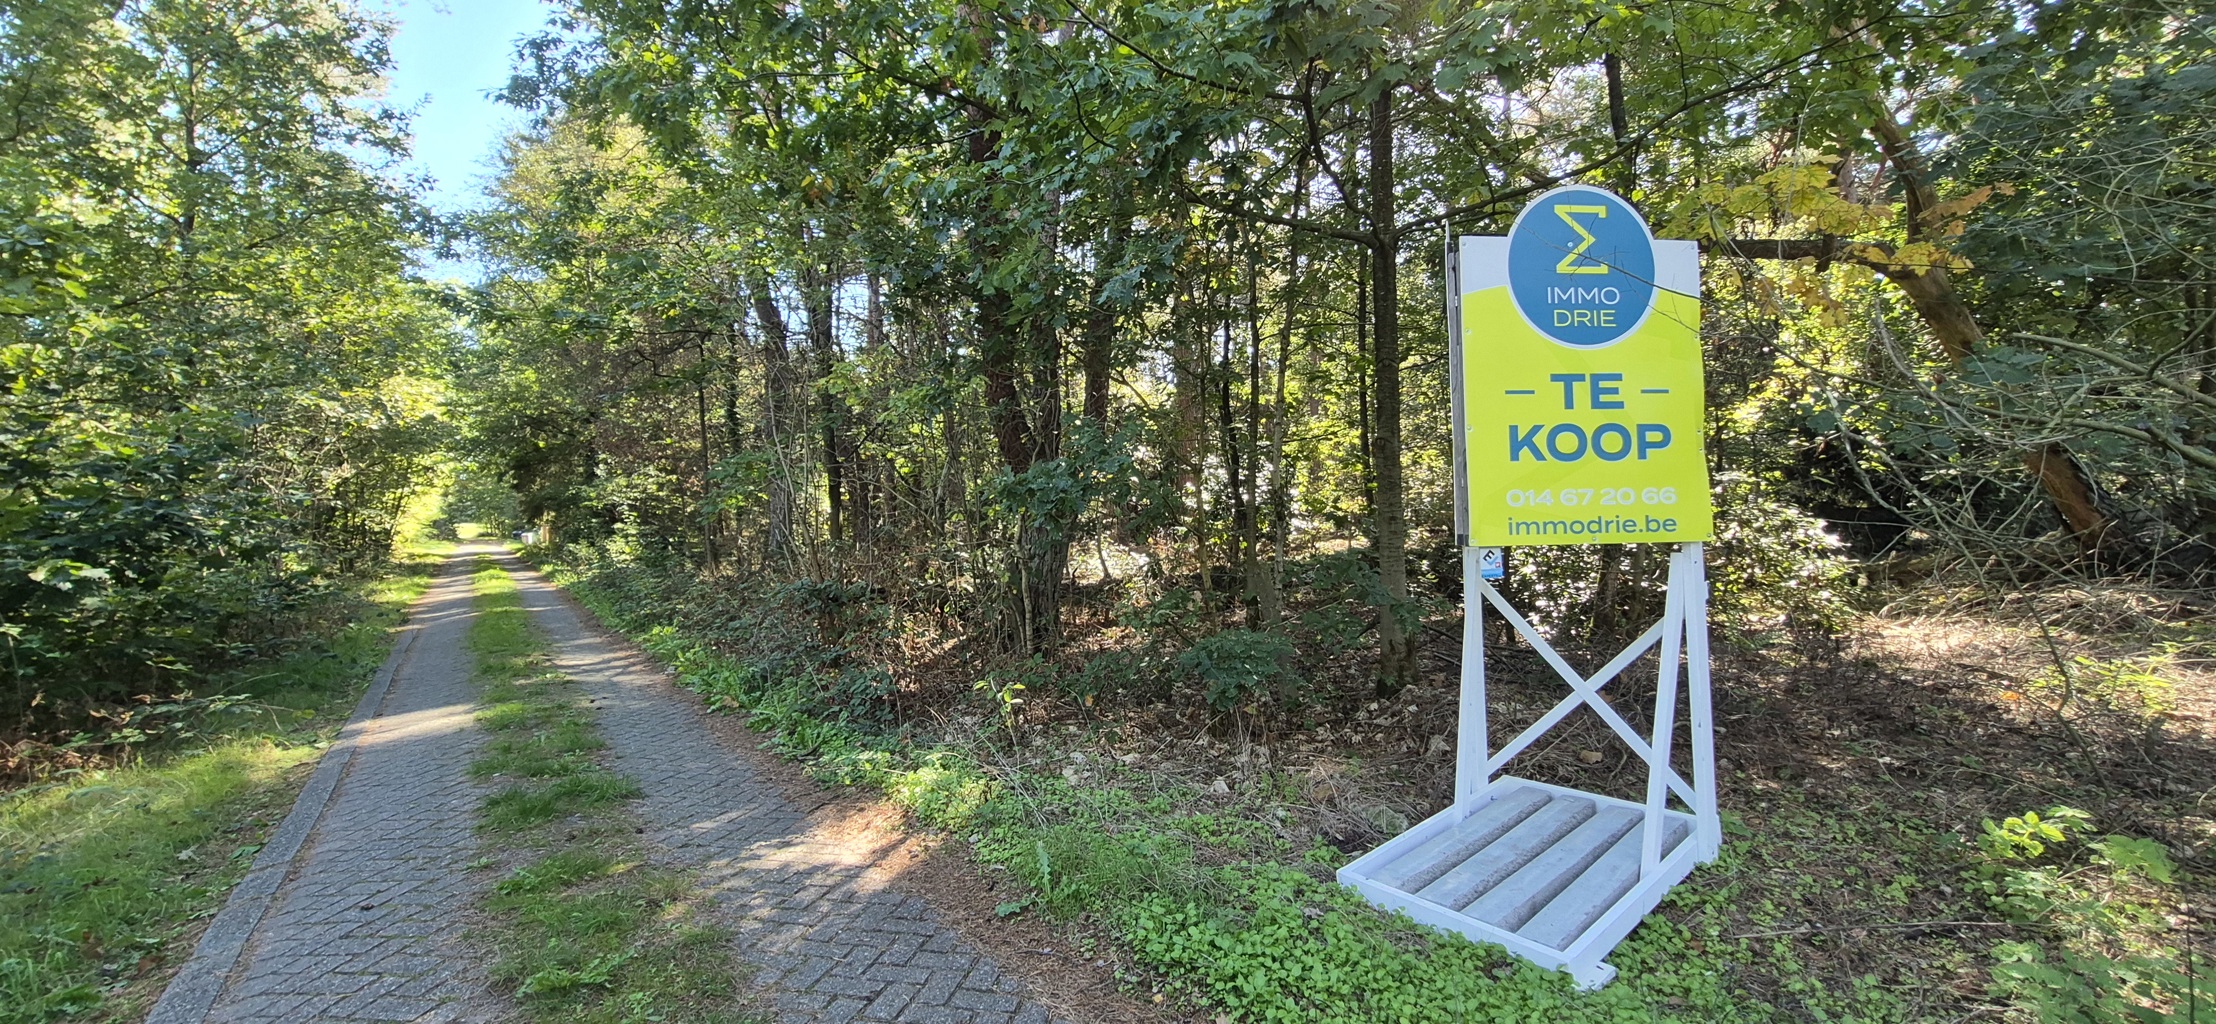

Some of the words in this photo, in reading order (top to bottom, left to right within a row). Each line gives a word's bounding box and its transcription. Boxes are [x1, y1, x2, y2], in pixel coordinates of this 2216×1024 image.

[1547, 286, 1620, 304] IMMO
[1554, 310, 1616, 327] DRIE
[1550, 373, 1625, 410] TE
[1508, 422, 1672, 462] KOOP
[1505, 489, 1553, 507] 014
[1559, 488, 1595, 505] 67
[1600, 487, 1636, 505] 20
[1641, 486, 1678, 504] 66
[1508, 515, 1678, 536] immodrie.be
